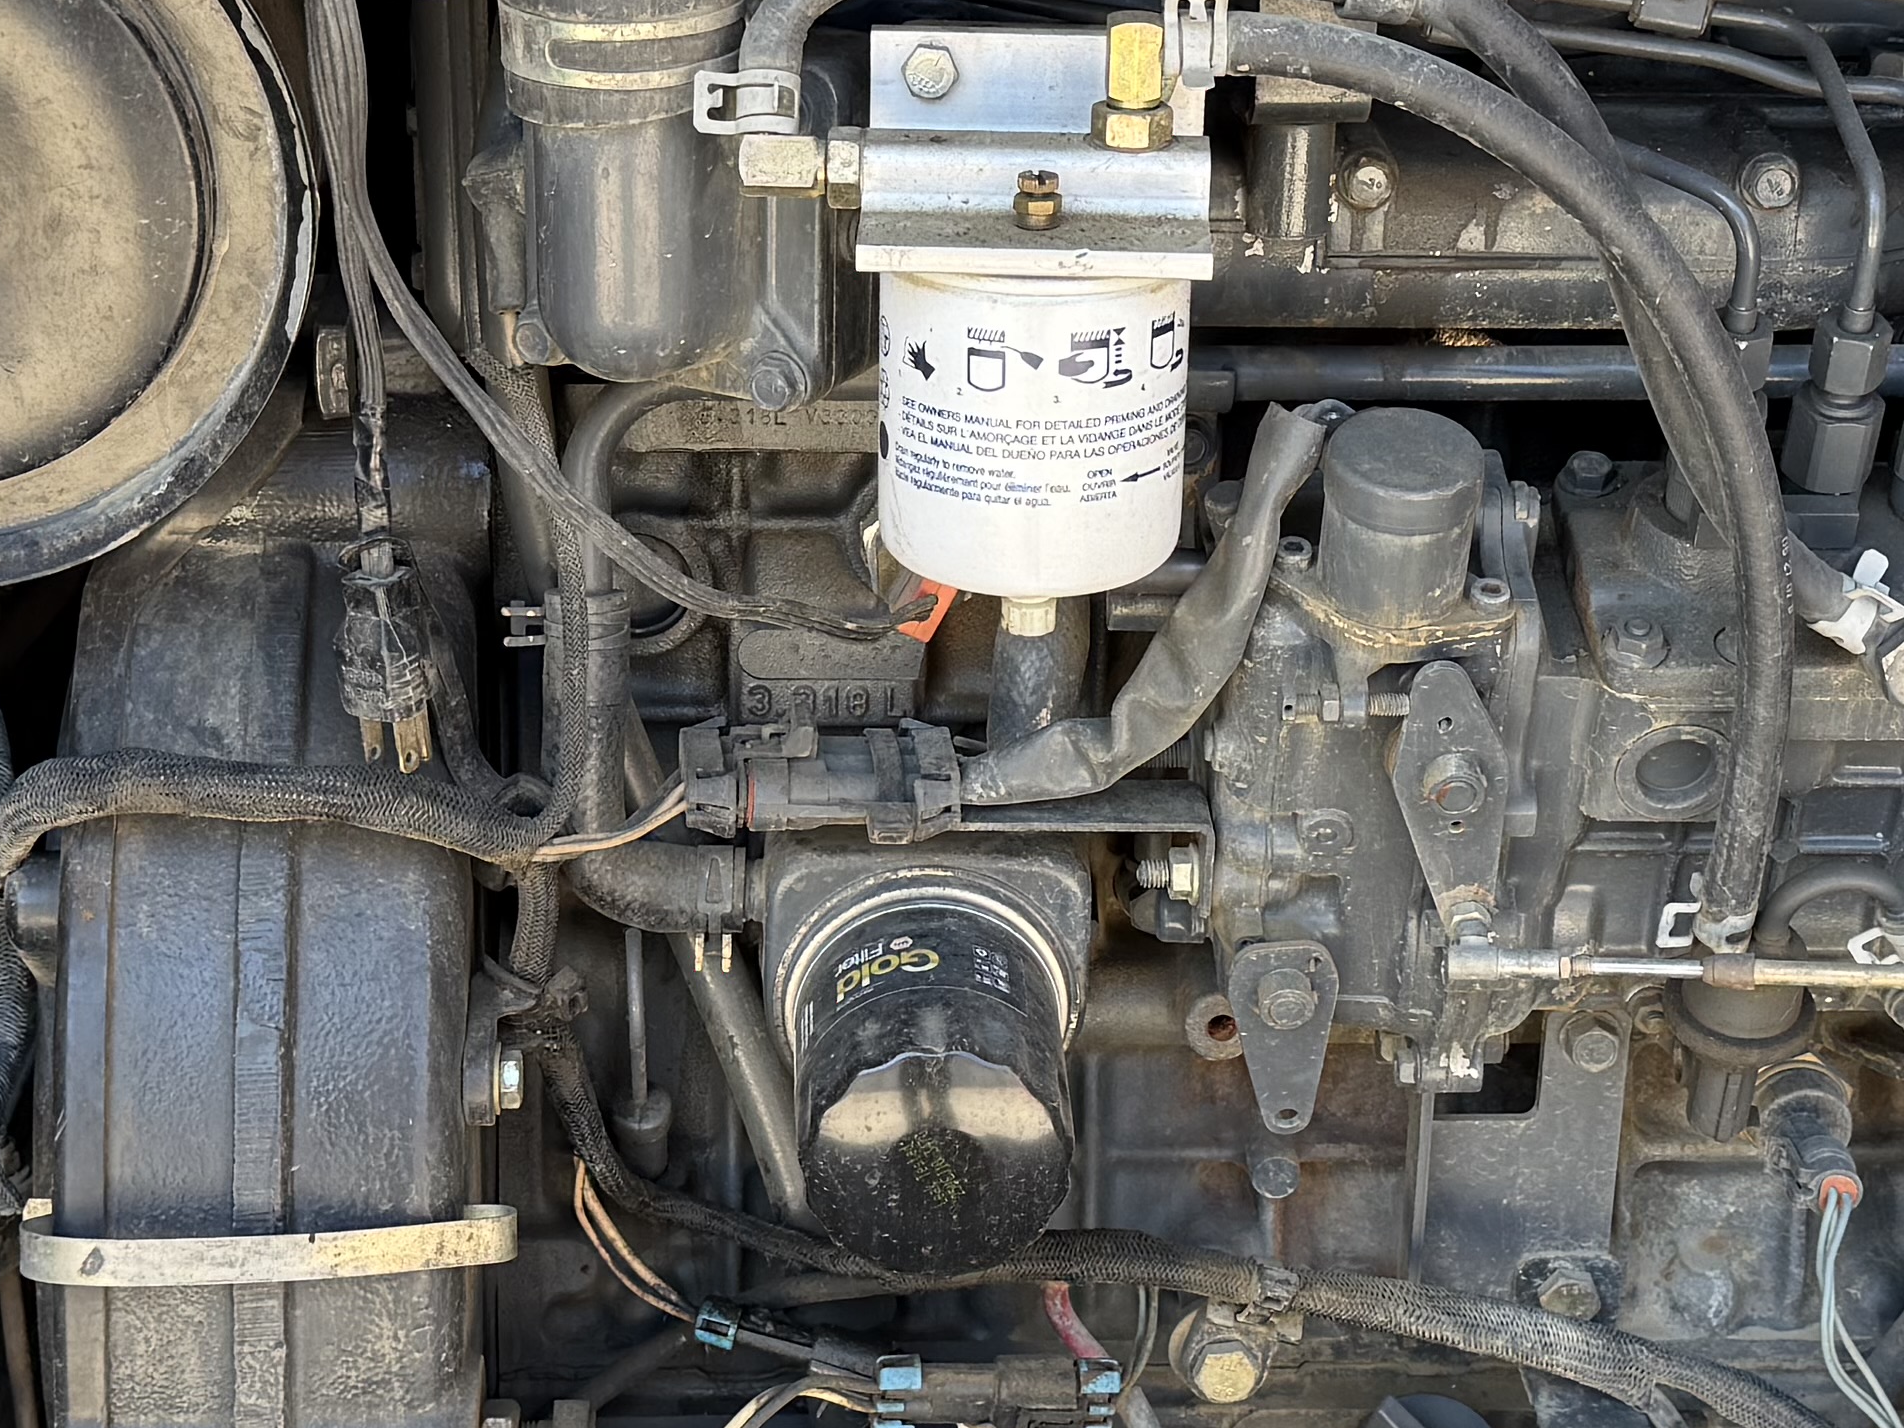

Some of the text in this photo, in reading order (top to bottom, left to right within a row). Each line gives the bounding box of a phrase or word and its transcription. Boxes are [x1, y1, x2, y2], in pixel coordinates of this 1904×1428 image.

[964, 414, 1012, 430] MANUAL
[1016, 420, 1040, 430] FOR
[1044, 418, 1101, 430] DETAILED
[1147, 401, 1163, 416] AND
[918, 432, 928, 444] EL
[930, 436, 973, 454] MANUAL
[976, 446, 998, 458] DEL
[1002, 447, 1045, 460] DUEÑO
[1050, 449, 1080, 461] PARA
[1084, 446, 1105, 458] LAS
[1107, 429, 1169, 455] OPERACIONES
[936, 422, 958, 436] SUR
[1042, 435, 1056, 445] ET
[1060, 435, 1075, 445] LA
[1078, 427, 1126, 444] VIDANGE
[1128, 420, 1153, 436] DANS
[952, 463, 985, 476] remove
[962, 490, 982, 503] para
[980, 481, 1002, 492] pour
[834, 942, 884, 978] Filter
[836, 948, 941, 1005] Gold
